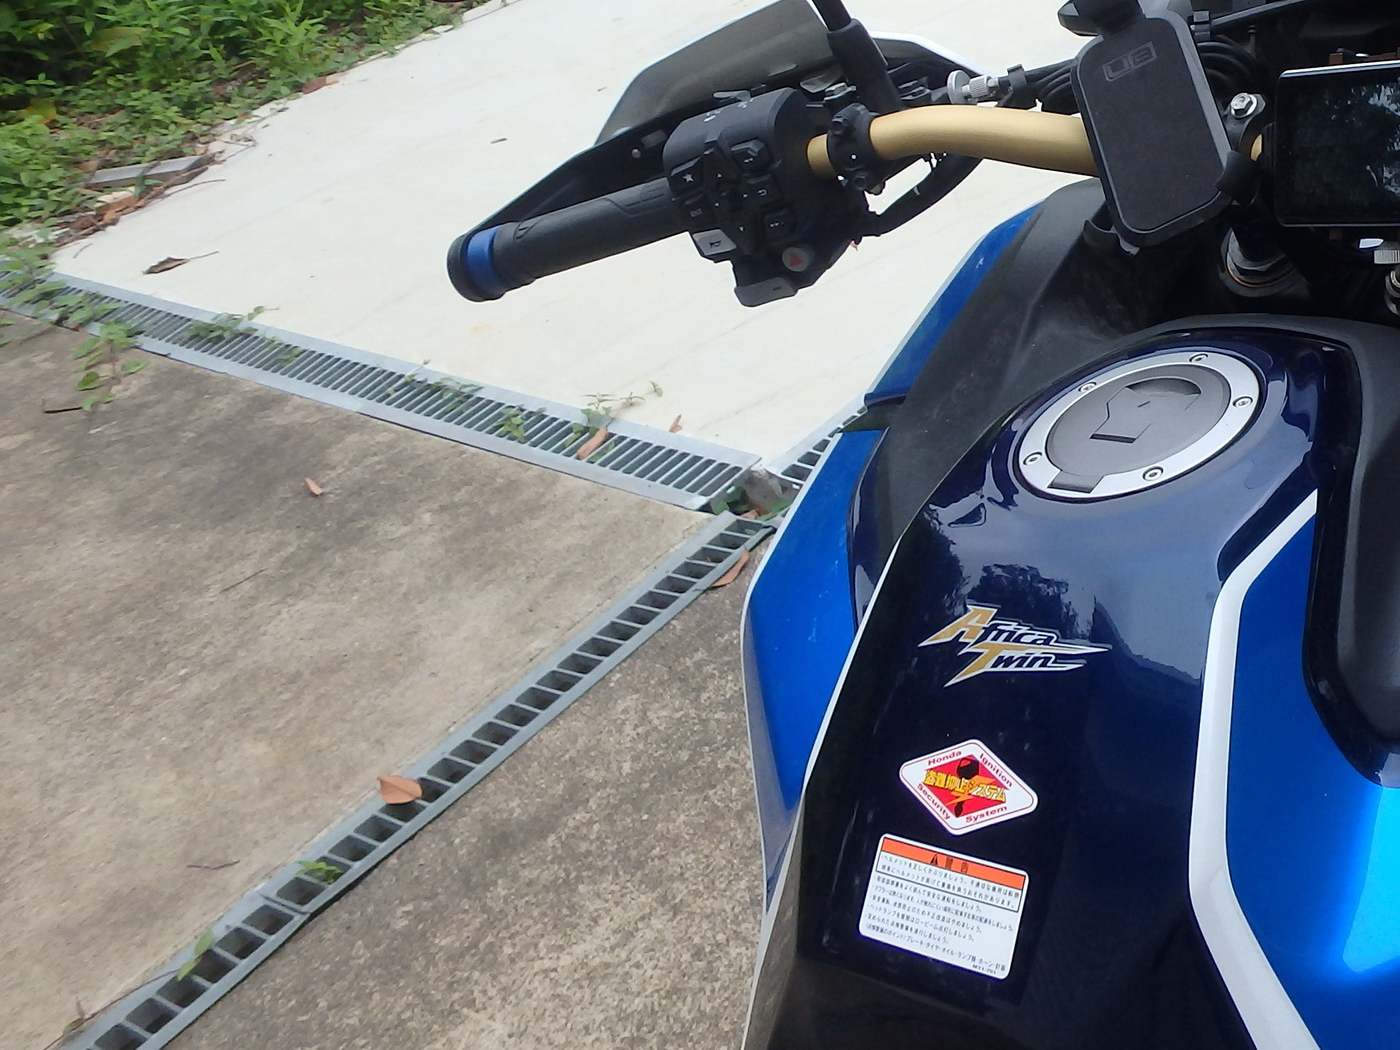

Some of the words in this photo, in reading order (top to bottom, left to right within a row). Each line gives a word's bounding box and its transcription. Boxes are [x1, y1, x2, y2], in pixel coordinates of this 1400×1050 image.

[917, 605, 1060, 655] Africa
[944, 642, 1097, 687] Twin
[927, 751, 962, 766] Honda
[980, 753, 1013, 787] Ignition
[917, 783, 951, 820] Security
[966, 806, 1007, 823] System
